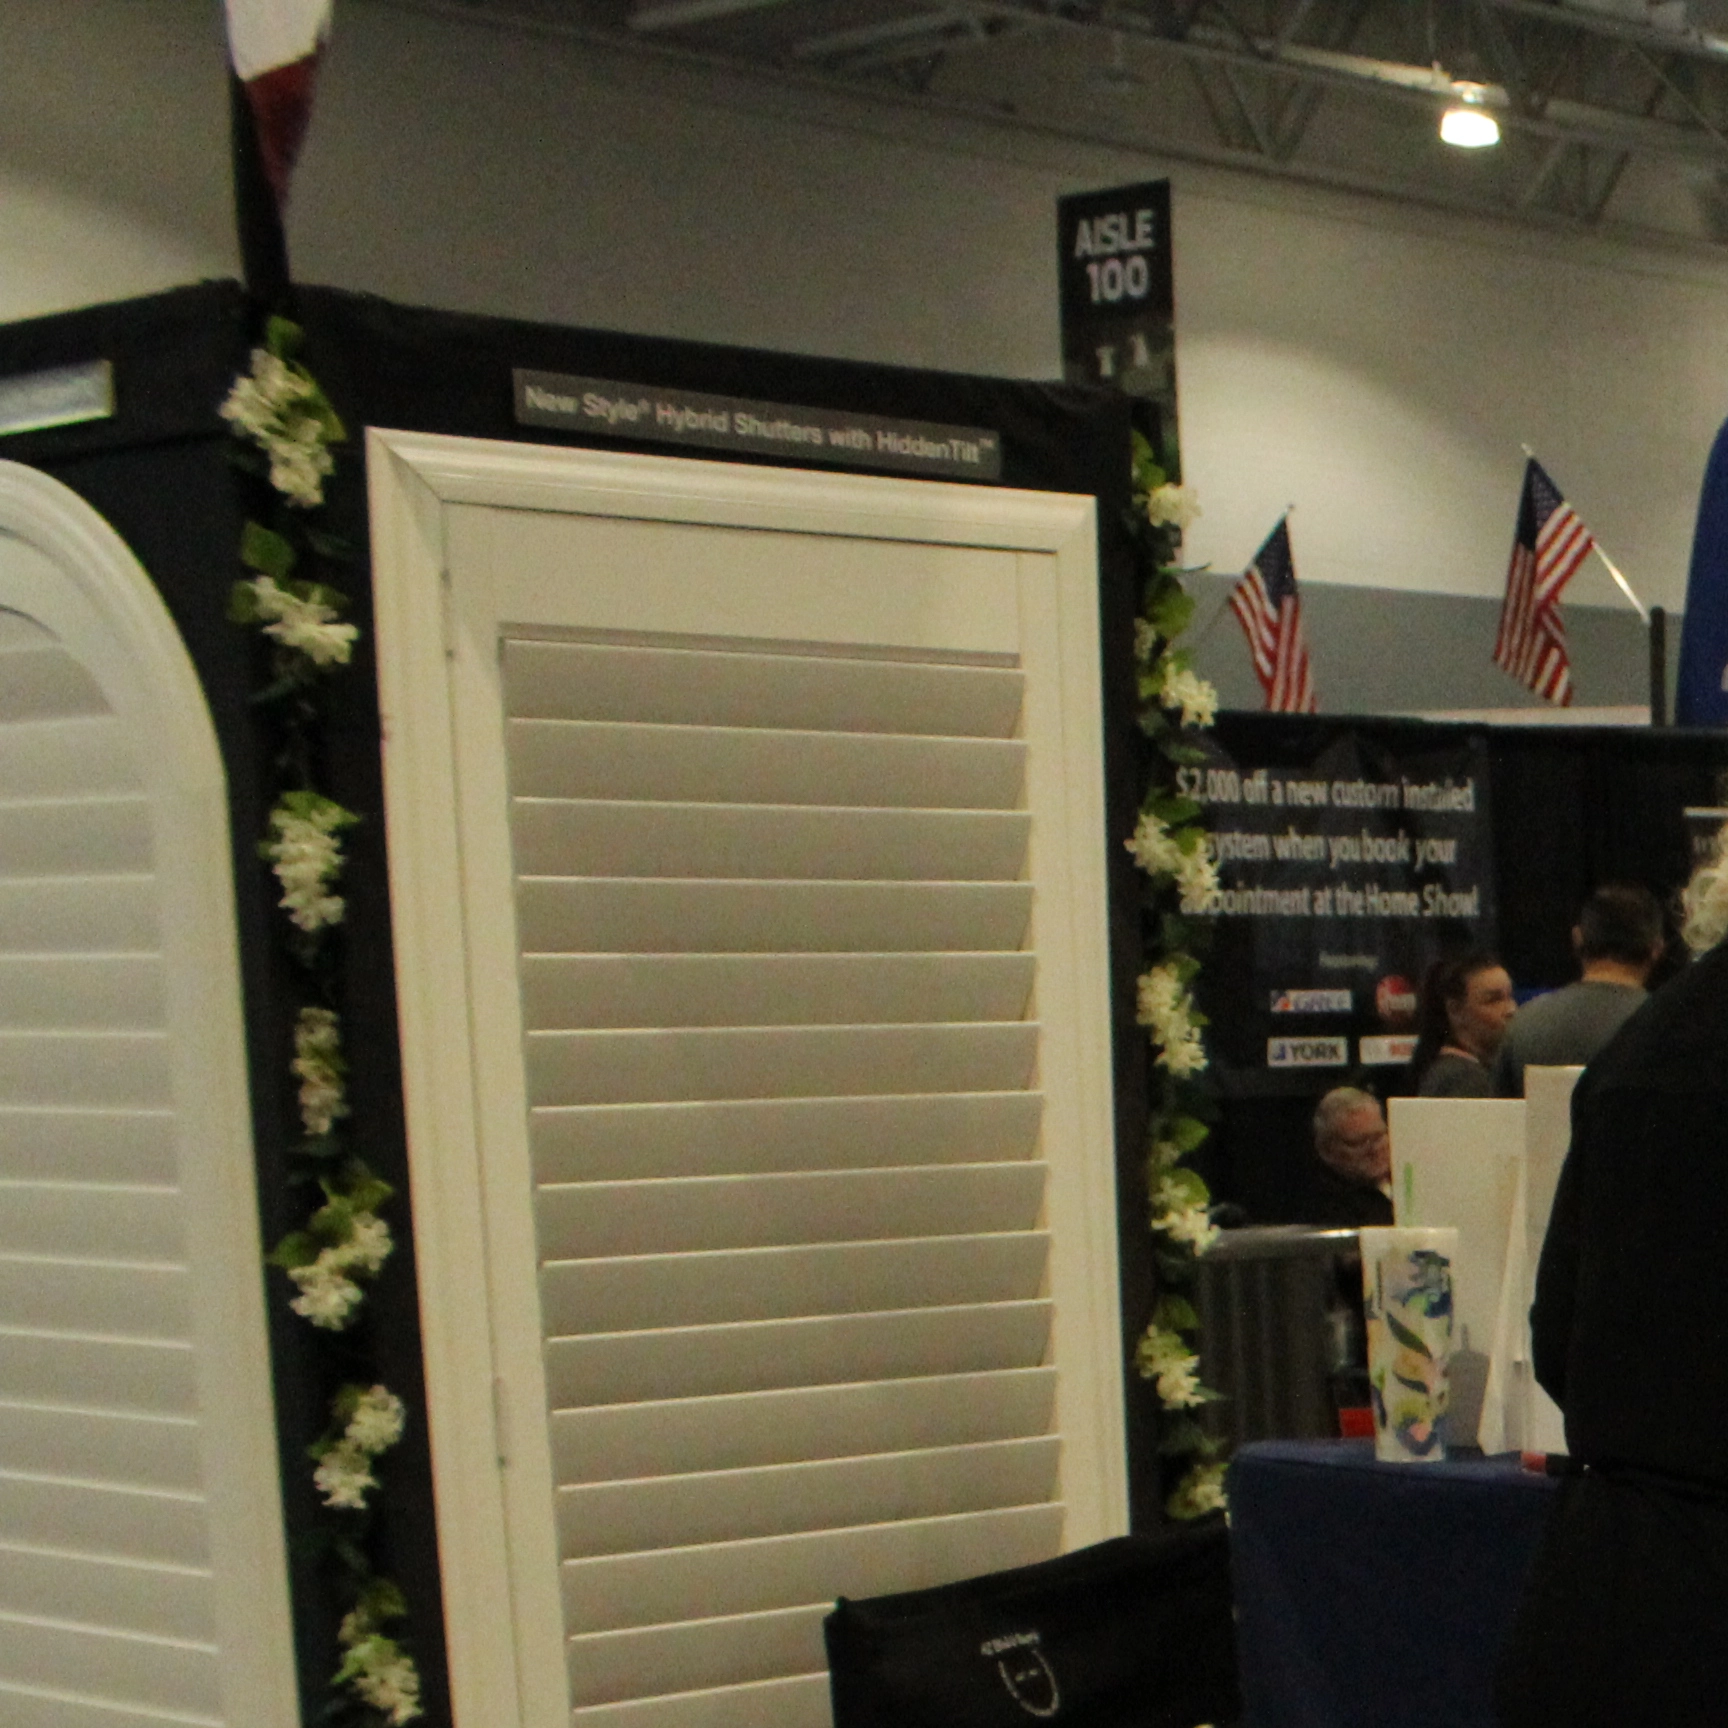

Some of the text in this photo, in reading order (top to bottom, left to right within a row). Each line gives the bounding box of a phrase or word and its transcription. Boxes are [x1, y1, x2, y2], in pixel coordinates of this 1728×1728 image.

[1074, 208, 1154, 260] AISLE
[1085, 253, 1150, 306] 100
[524, 386, 578, 414] New
[655, 402, 730, 435] Hybrid
[733, 412, 823, 446] Shutters
[826, 426, 870, 452] with
[1243, 768, 1269, 804] off
[1286, 780, 1328, 807] new
[1330, 777, 1400, 808] custom
[1364, 881, 1421, 917] Home
